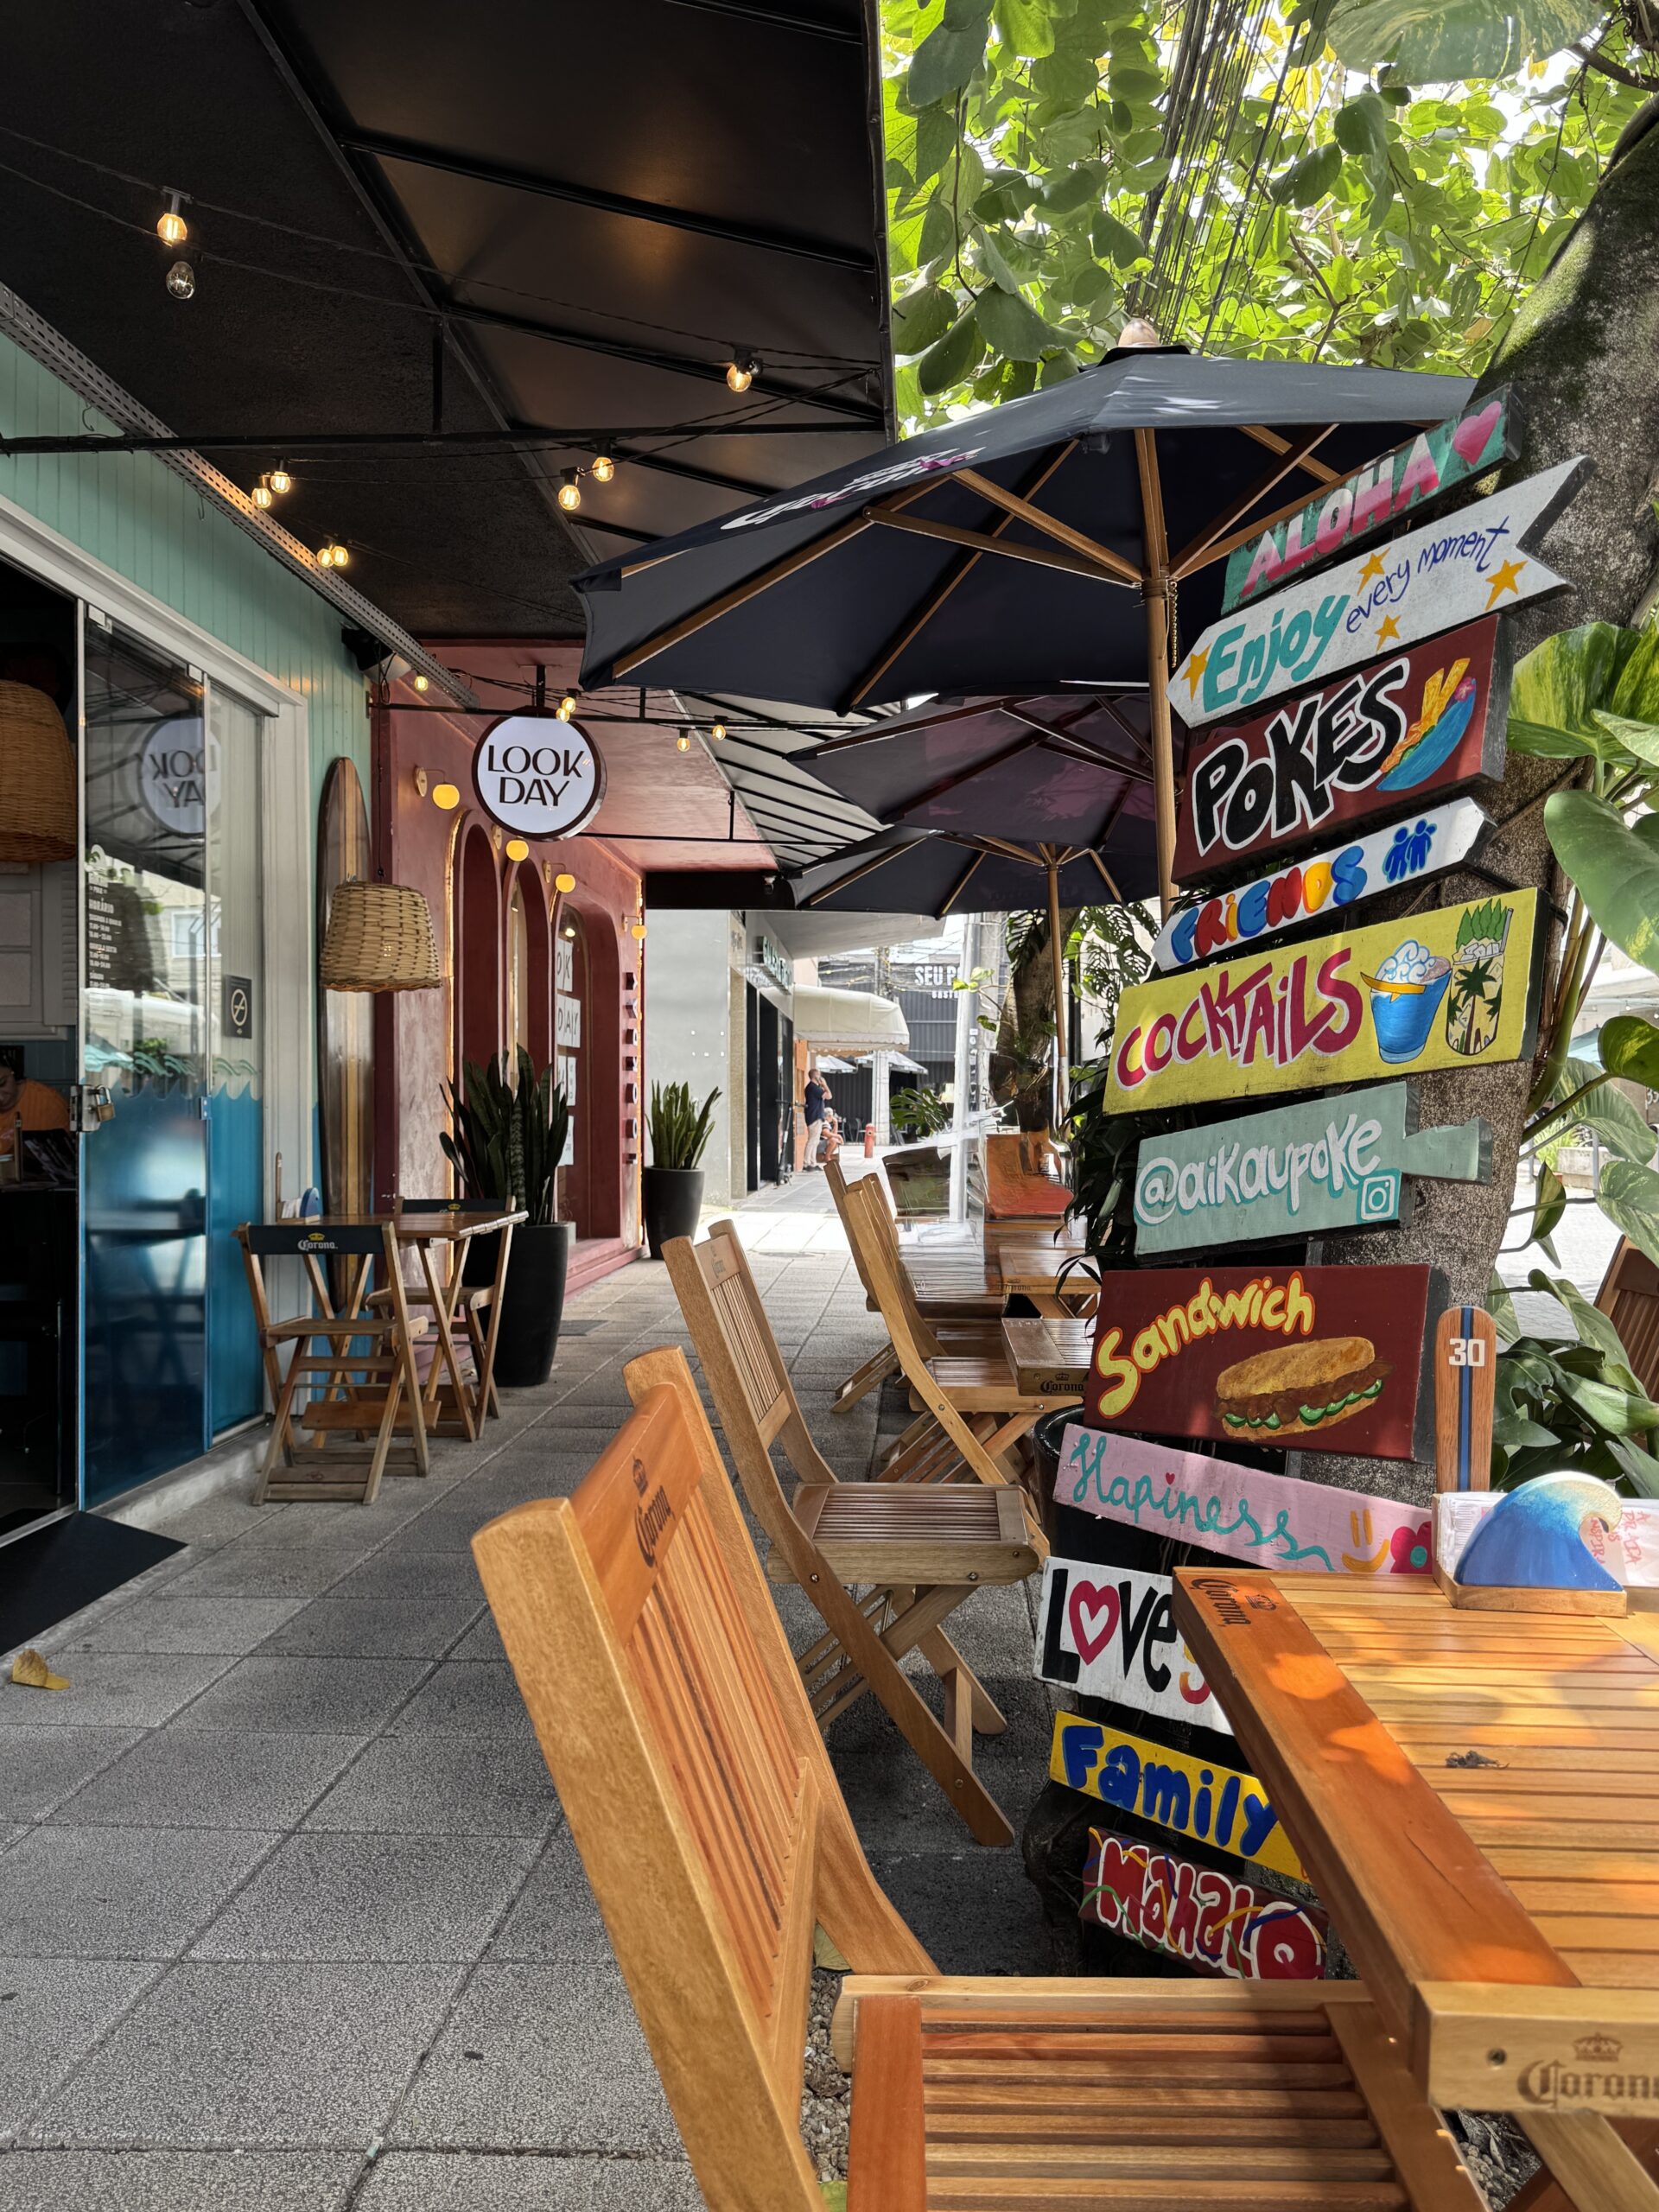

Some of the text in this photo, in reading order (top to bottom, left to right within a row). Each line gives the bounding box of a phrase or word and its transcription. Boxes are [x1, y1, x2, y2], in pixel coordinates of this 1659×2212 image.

[1241, 433, 1440, 598] ALOHA
[1202, 594, 1350, 714] Enjoy
[1346, 561, 1411, 634] every
[487, 745, 585, 778] LOOK
[499, 777, 570, 806] DAY
[914, 965, 944, 986] SEU
[1095, 1270, 1316, 1420] Sandwich
[1448, 1338, 1485, 1367] 30
[1039, 1380, 1084, 1395] Corona
[1189, 1578, 1252, 1627] Corona
[1062, 1726, 1280, 1856] Family
[1516, 2059, 1659, 2109] Coron
